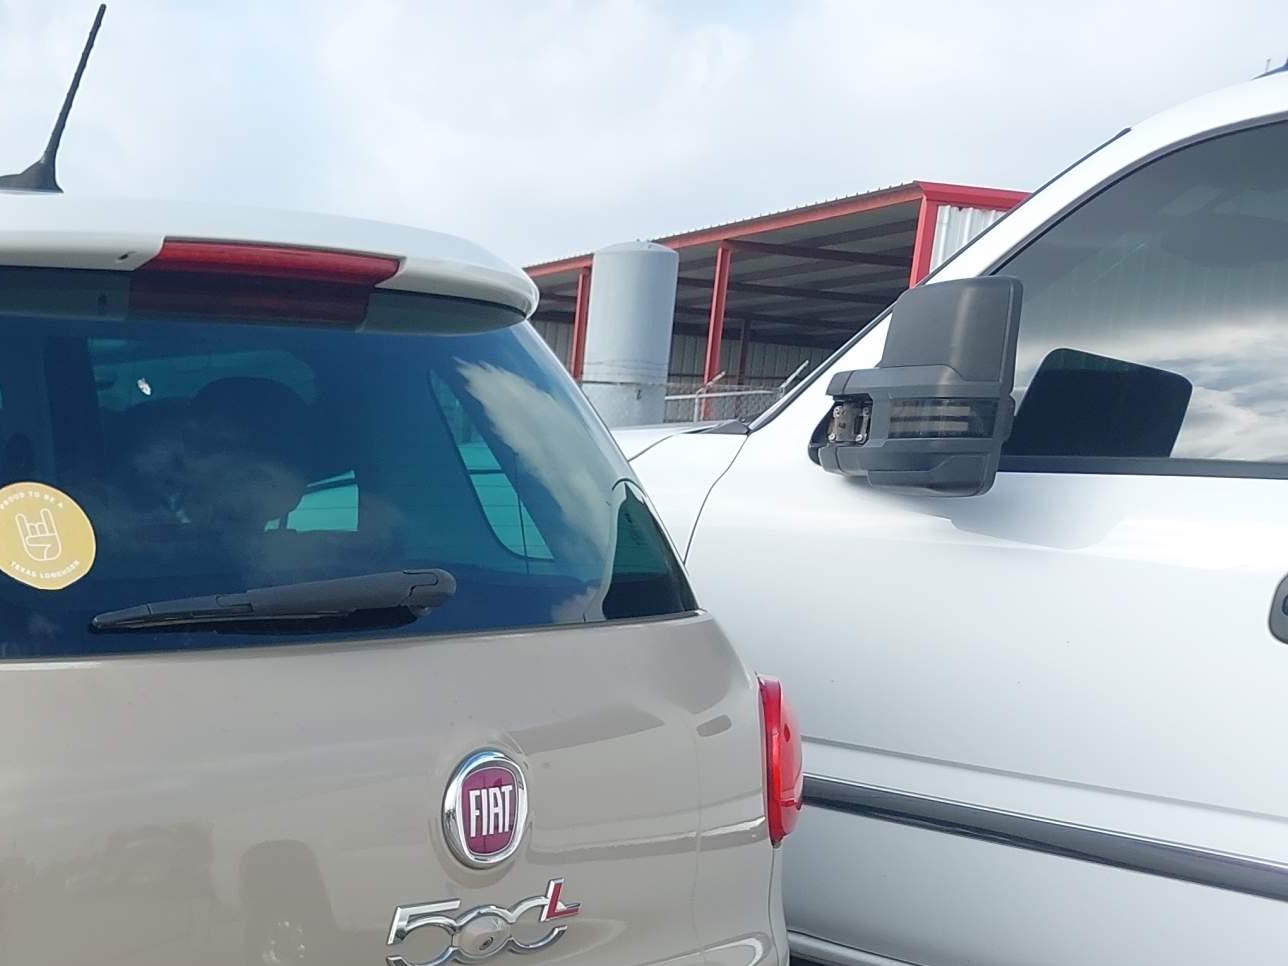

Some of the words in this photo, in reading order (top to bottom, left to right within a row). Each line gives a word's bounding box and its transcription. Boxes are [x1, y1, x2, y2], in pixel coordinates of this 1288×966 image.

[28, 490, 40, 498] TO
[10, 560, 37, 577] TEXAS
[468, 785, 513, 837] FIAT
